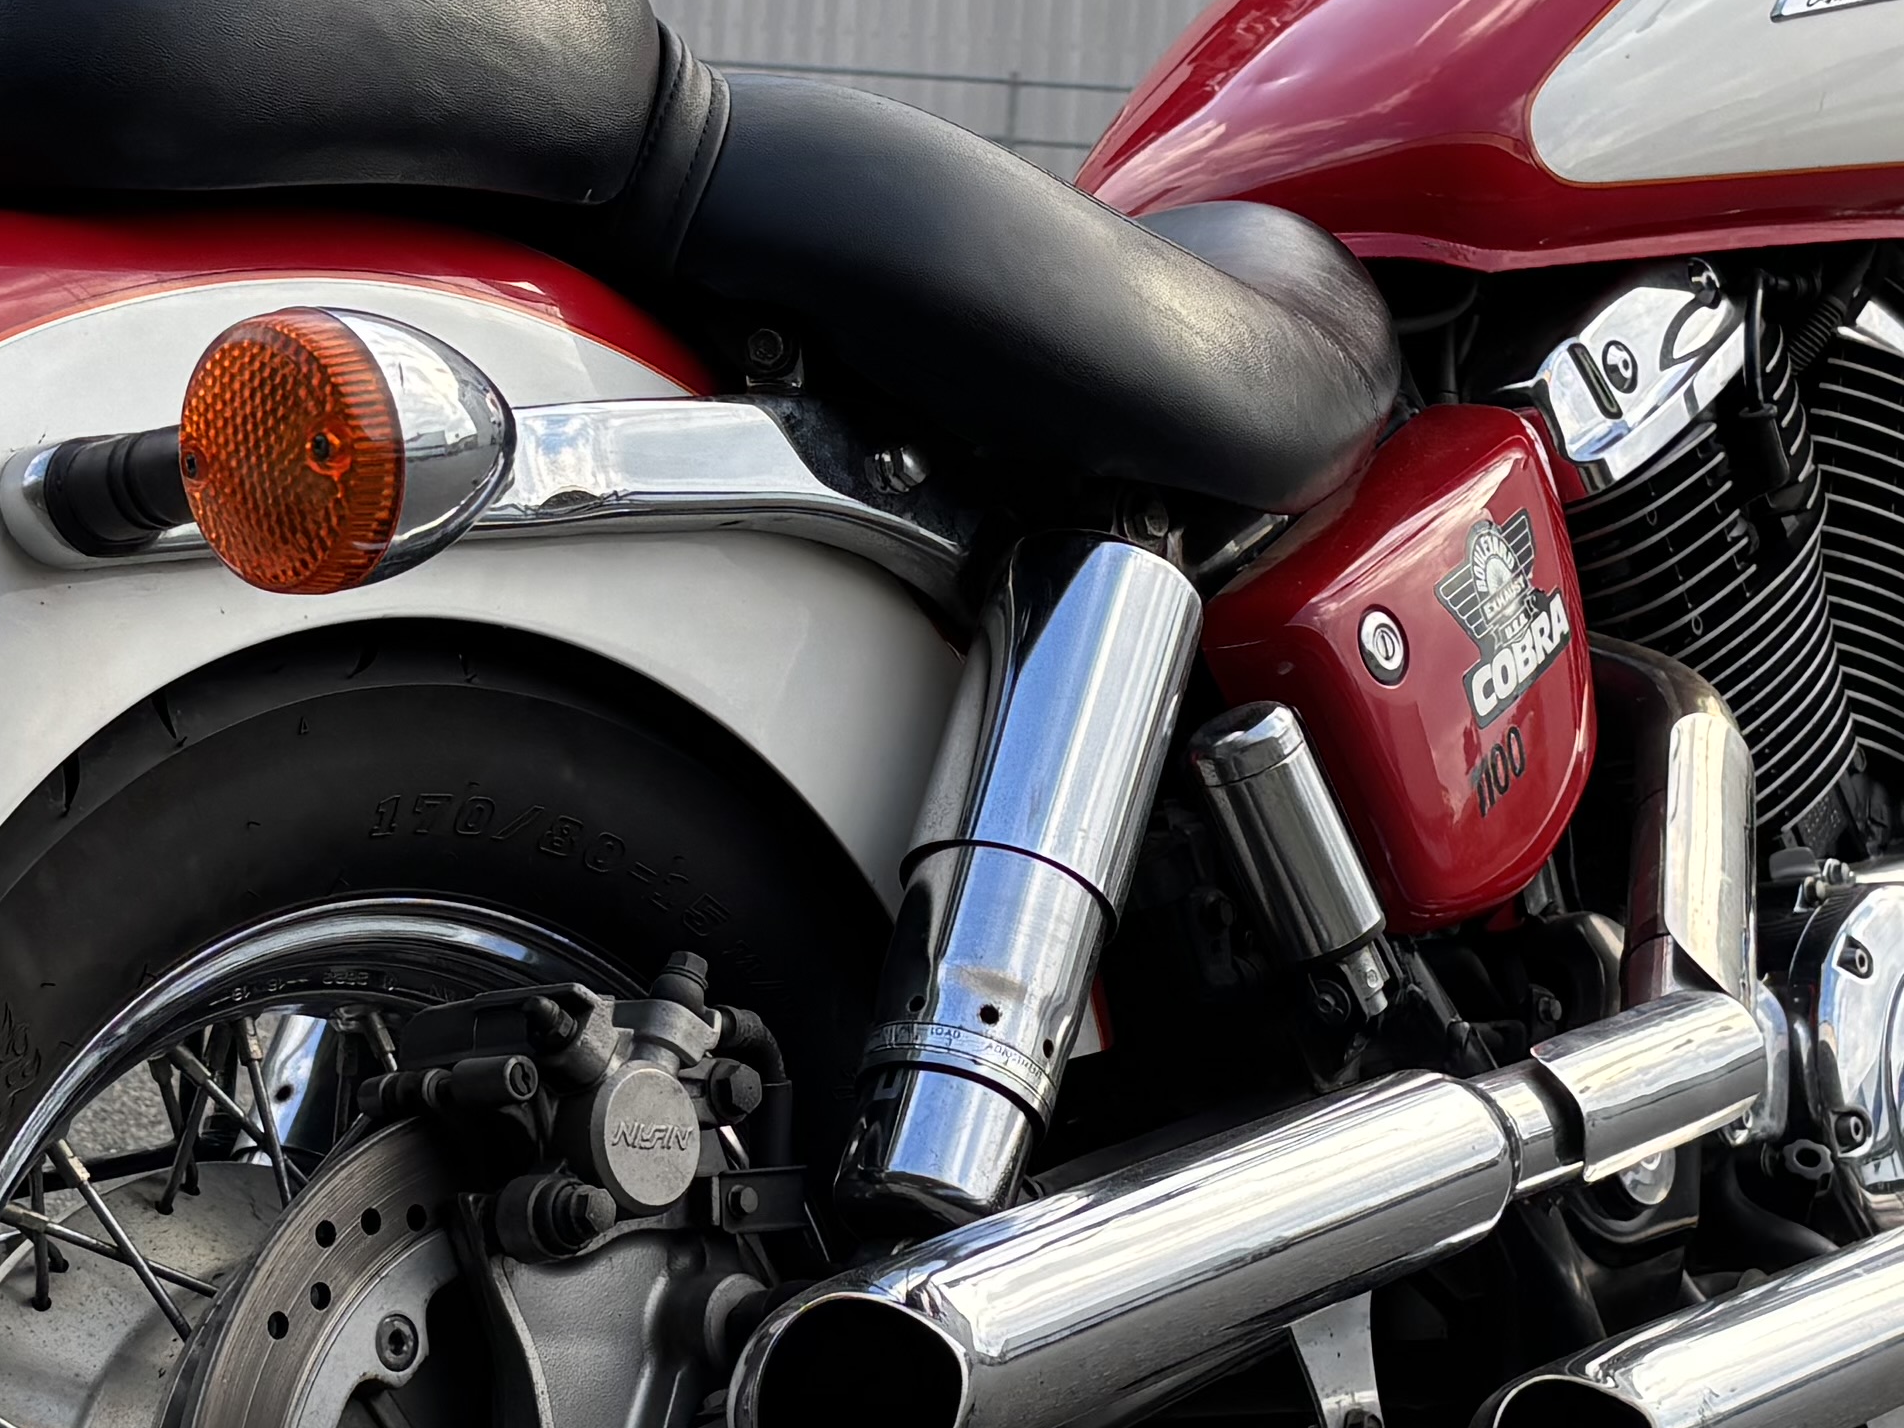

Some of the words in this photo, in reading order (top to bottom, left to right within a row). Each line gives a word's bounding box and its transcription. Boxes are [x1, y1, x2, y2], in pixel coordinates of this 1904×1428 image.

[1483, 576, 1528, 620] EXHAUST
[1471, 596, 1571, 717] COBRA
[1475, 725, 1528, 818] 1100
